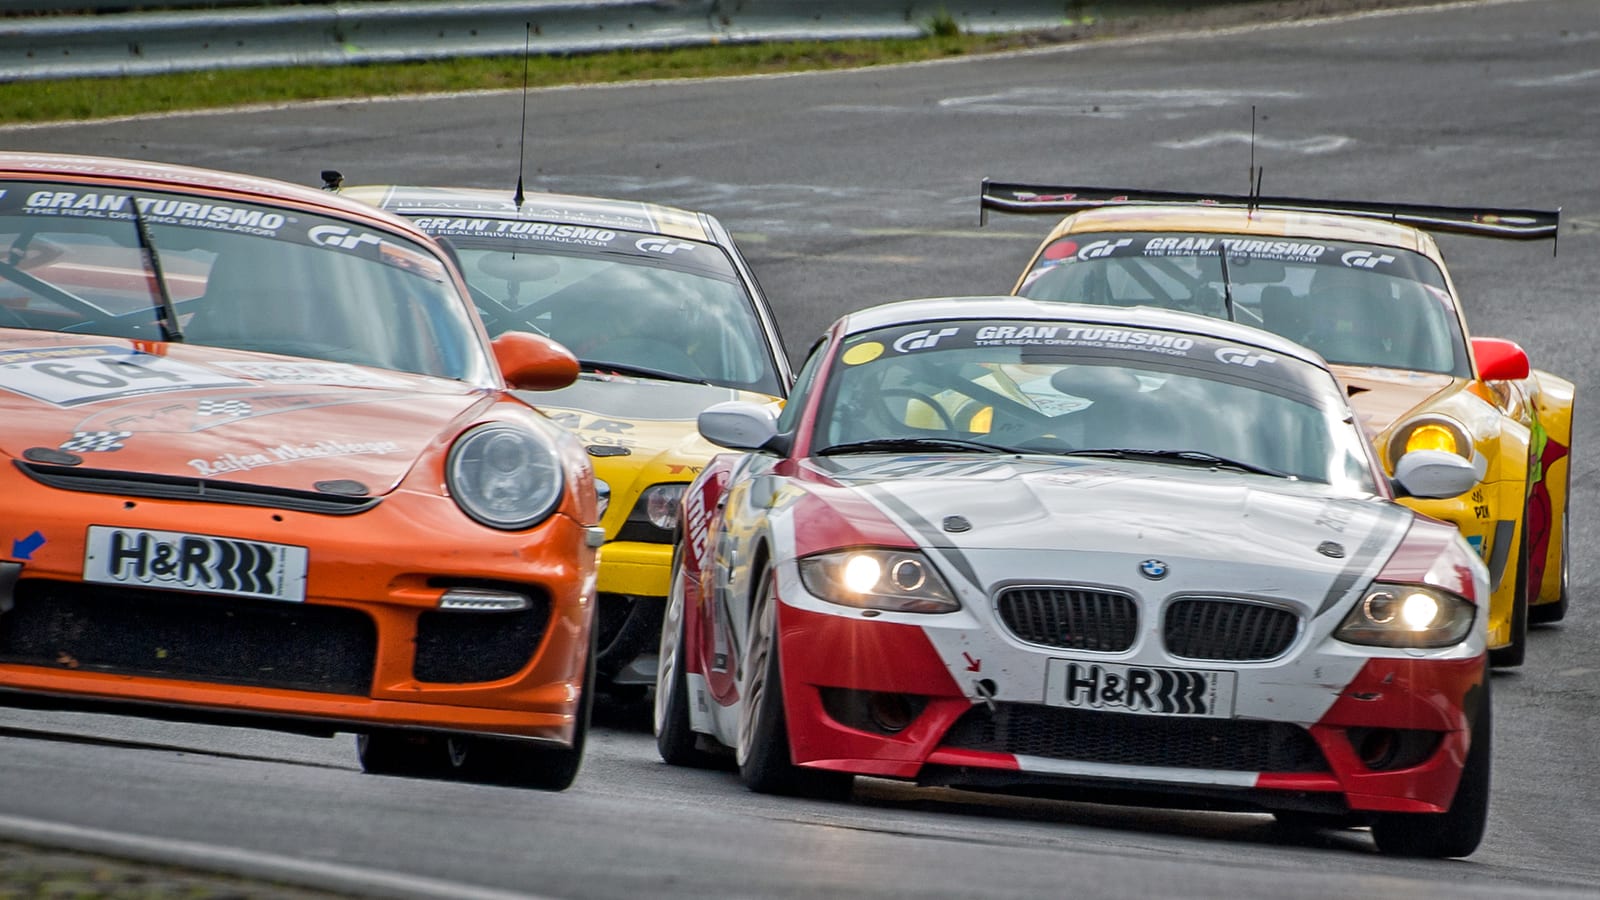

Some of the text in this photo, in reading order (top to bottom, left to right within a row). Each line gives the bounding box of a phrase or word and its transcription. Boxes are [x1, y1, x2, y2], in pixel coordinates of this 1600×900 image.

[22, 207, 58, 215] THE
[61, 208, 107, 218] REAL
[180, 217, 276, 237] SIMULATOR
[26, 190, 285, 229] GRAN TURISMO
[414, 217, 616, 242] GRAN TURISMO
[474, 231, 529, 240] DRIVING
[532, 235, 608, 247] SIMULATOR
[1144, 237, 1326, 257] GRAN TURISMO
[1199, 250, 1248, 258] DRIING
[1250, 252, 1317, 263] SIMULATOR
[975, 326, 1195, 351] GRAN TURISMO
[1044, 339, 1104, 348] DRIVING
[1105, 342, 1188, 357] SIMULATOR
[31, 357, 188, 389] 64
[187, 452, 272, 476] Reifen
[109, 530, 218, 589] H&R
[1066, 662, 1160, 713] H&R
